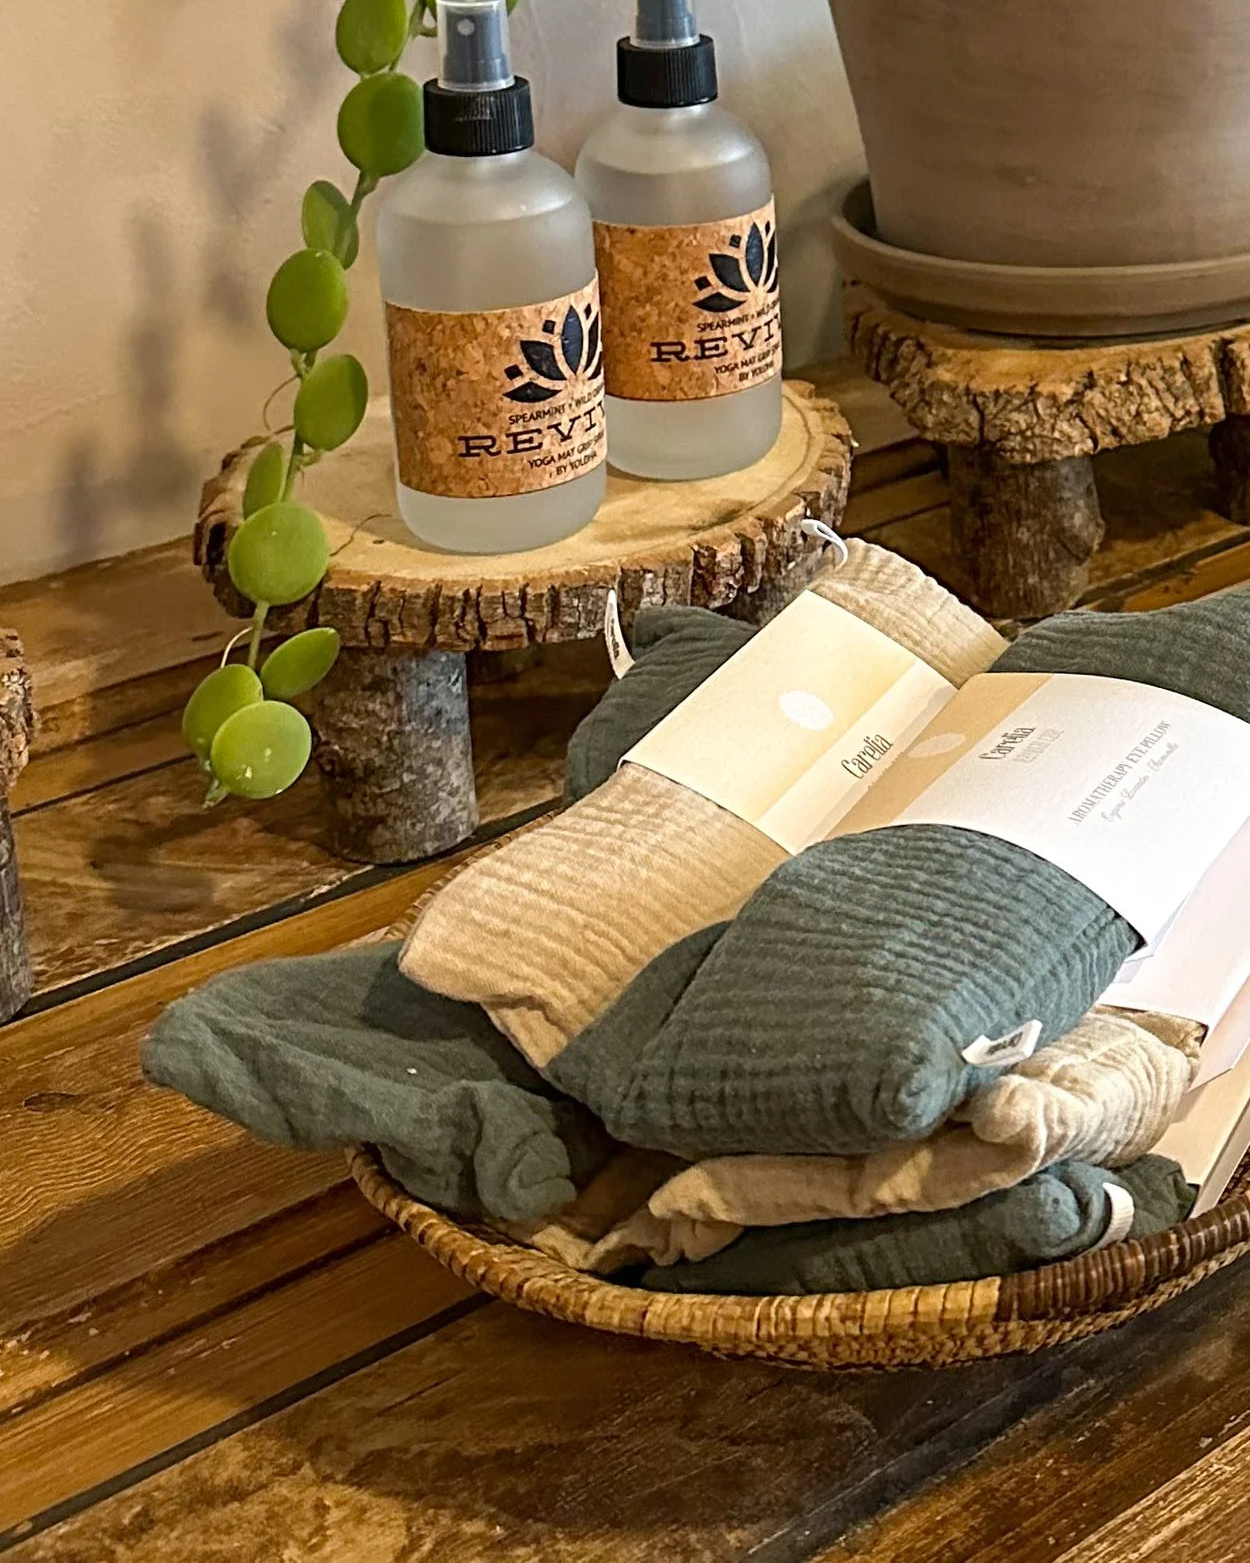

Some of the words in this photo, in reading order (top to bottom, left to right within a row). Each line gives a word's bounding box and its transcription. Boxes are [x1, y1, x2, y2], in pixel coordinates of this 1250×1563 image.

[714, 360, 739, 375] YOGA
[508, 403, 566, 425] SPEARMINT
[527, 454, 556, 469] YOGA
[557, 447, 576, 463] MAT
[556, 465, 568, 477] BY
[978, 727, 1036, 760] Carelia
[841, 734, 894, 779] Carelia
[1068, 763, 1132, 823] AROMATHERAPY
[1139, 720, 1171, 749] PILLOW
